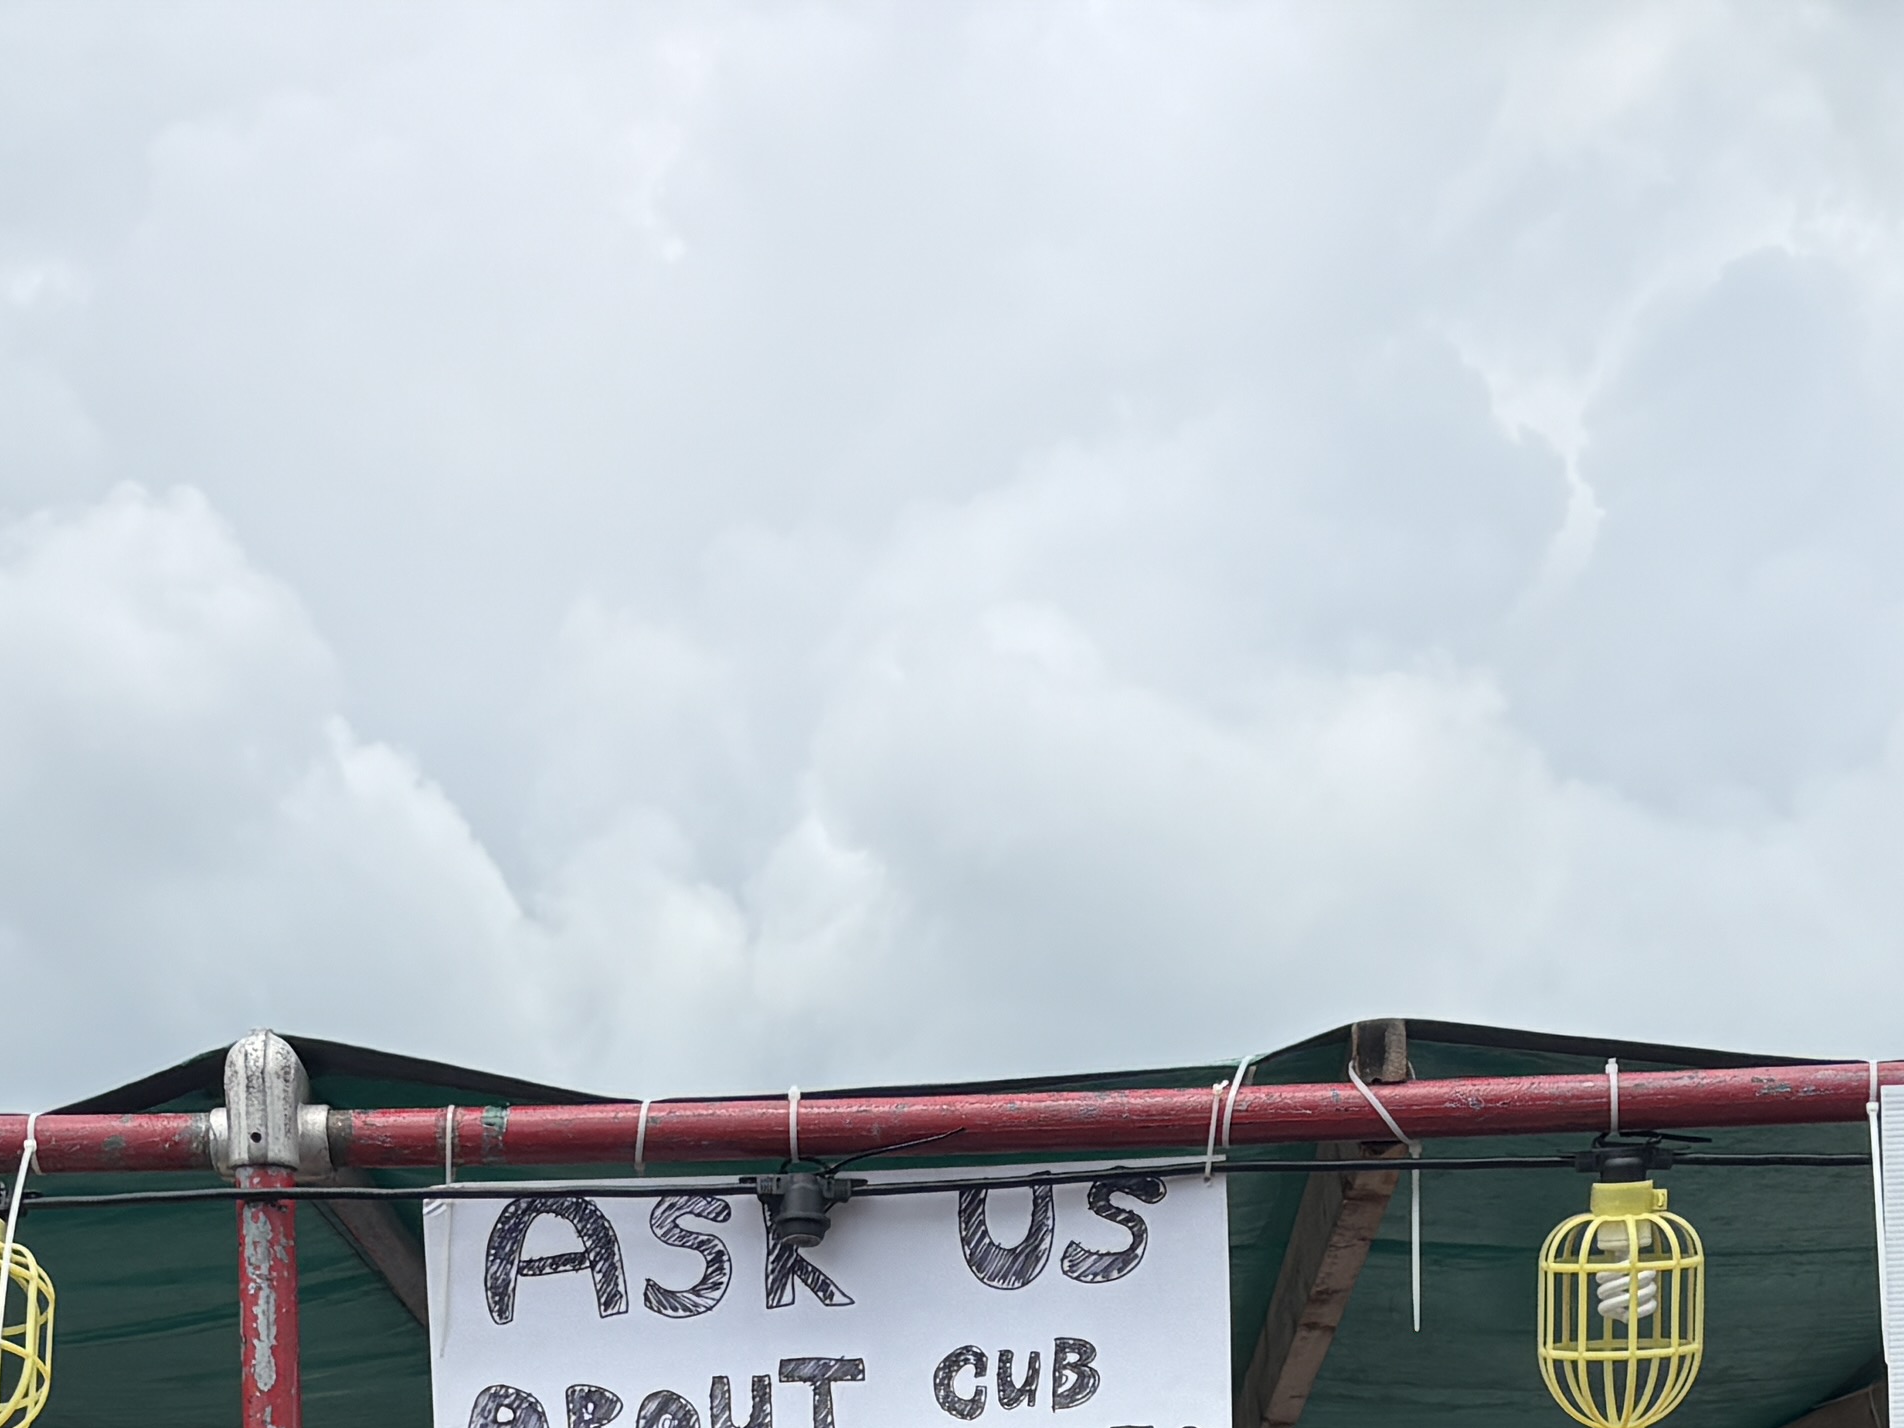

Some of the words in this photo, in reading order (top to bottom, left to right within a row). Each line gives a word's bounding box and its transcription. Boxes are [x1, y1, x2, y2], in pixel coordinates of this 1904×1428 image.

[485, 1195, 855, 1325] ASK
[959, 1176, 1167, 1289] US
[934, 1337, 1100, 1420] CUB
